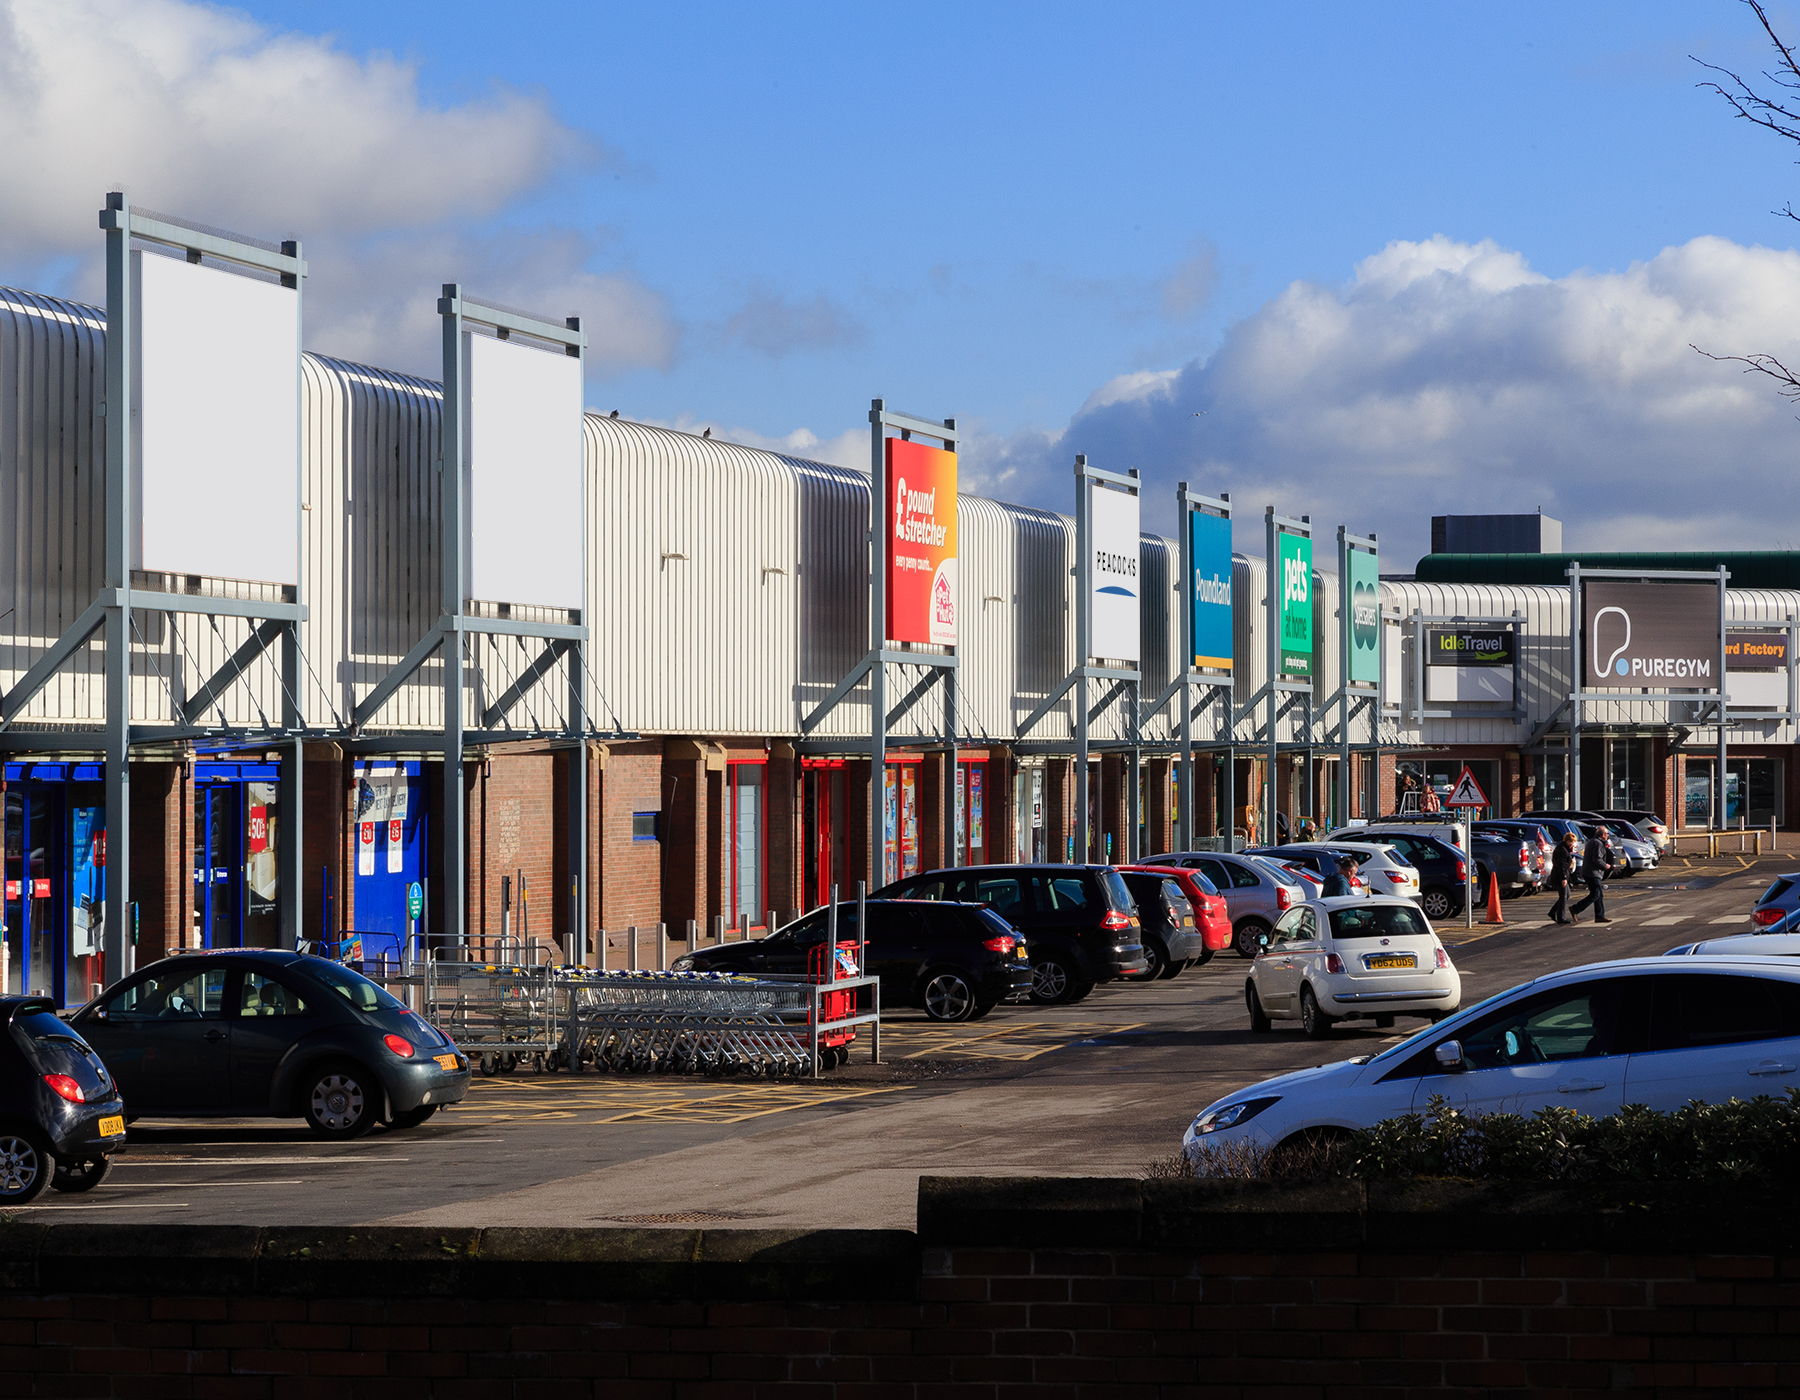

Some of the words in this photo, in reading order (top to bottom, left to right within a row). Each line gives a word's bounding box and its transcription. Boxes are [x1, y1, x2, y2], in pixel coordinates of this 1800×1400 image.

[906, 487, 936, 519] pound
[905, 514, 947, 546] stretcher
[1097, 551, 1136, 577] PEACOCKS
[1196, 568, 1231, 606] Poundland
[1284, 548, 1307, 611] pets
[1285, 608, 1291, 638] at
[1292, 605, 1307, 640] home
[1440, 635, 1502, 650] IdleTravel
[1743, 642, 1785, 658] Factory
[1631, 658, 1710, 678] PUREGYM
[1396, 958, 1414, 967] UDS
